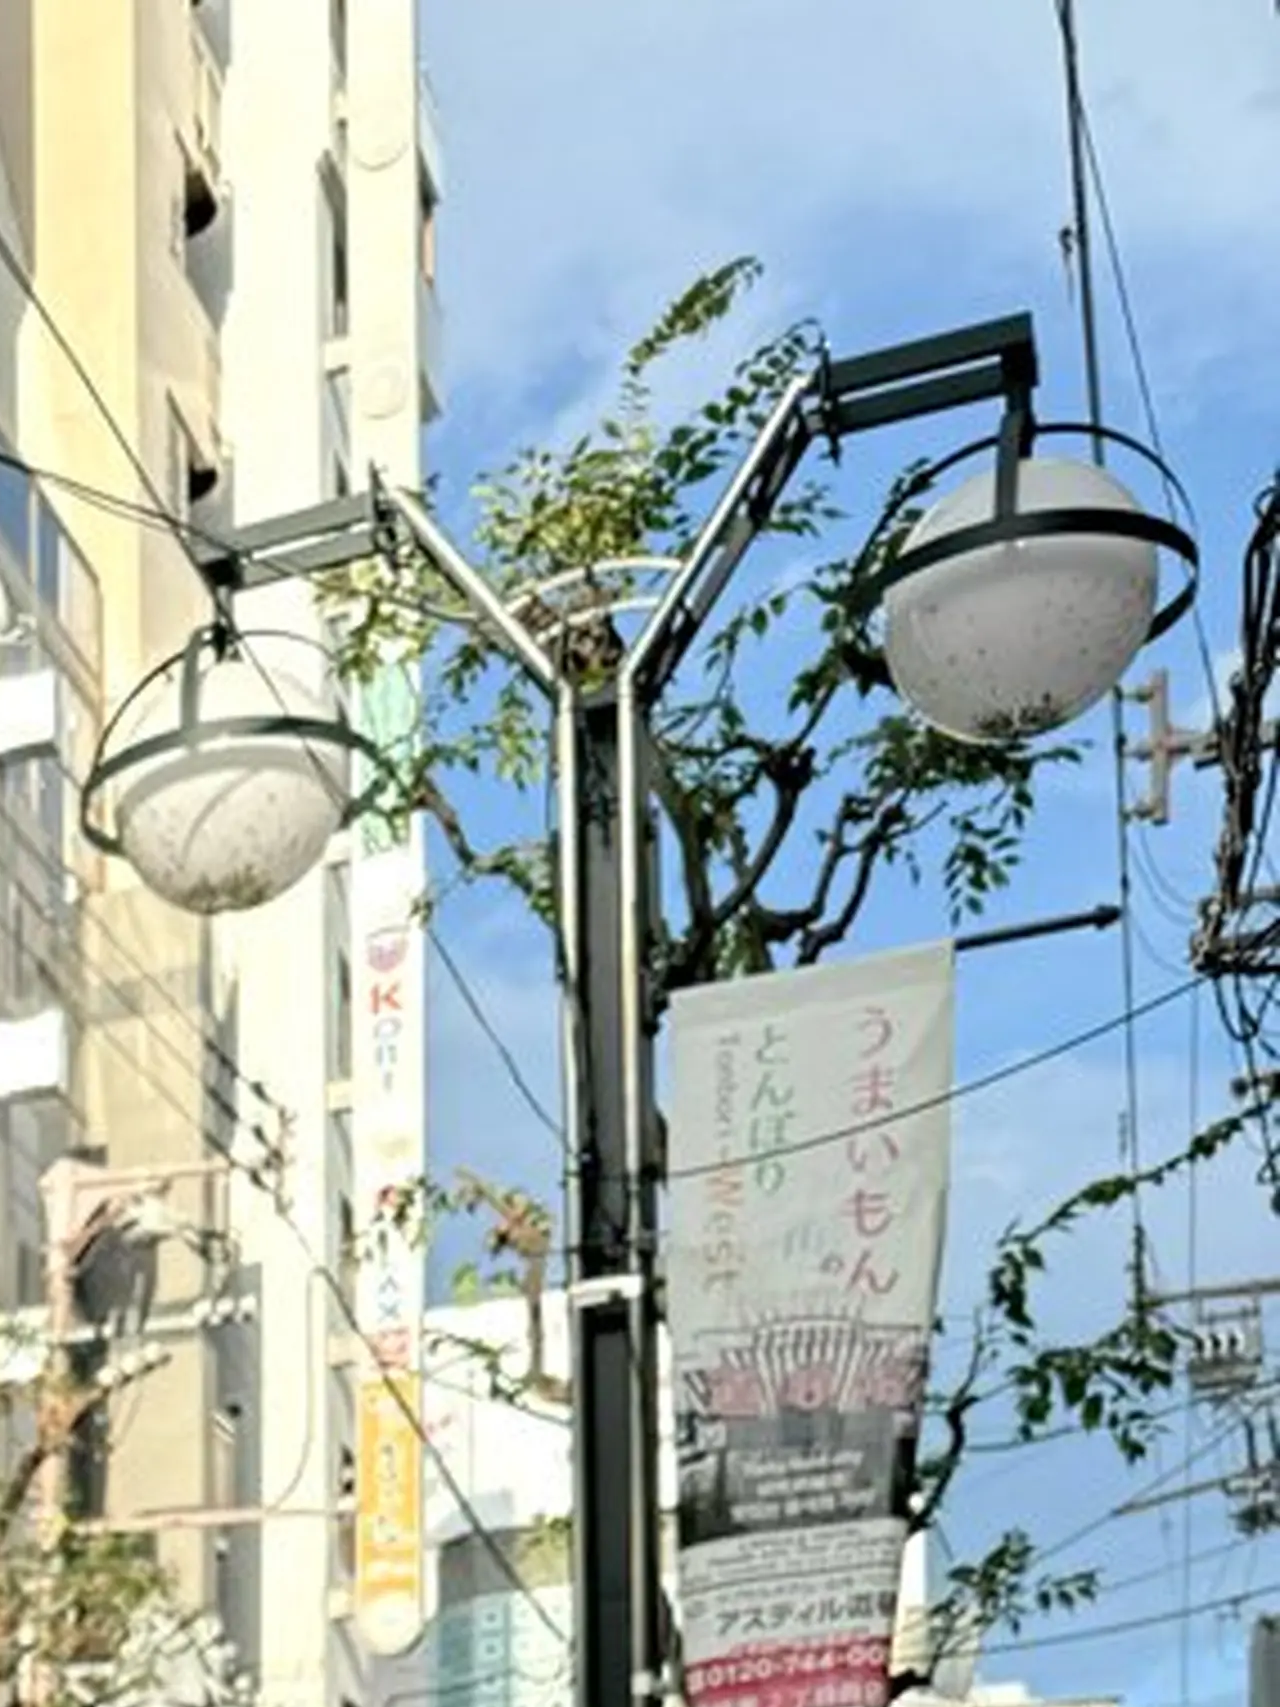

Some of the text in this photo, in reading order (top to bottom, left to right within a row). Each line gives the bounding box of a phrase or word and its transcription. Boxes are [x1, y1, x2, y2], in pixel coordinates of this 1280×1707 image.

[838, 1005, 900, 1297] うまいもん
